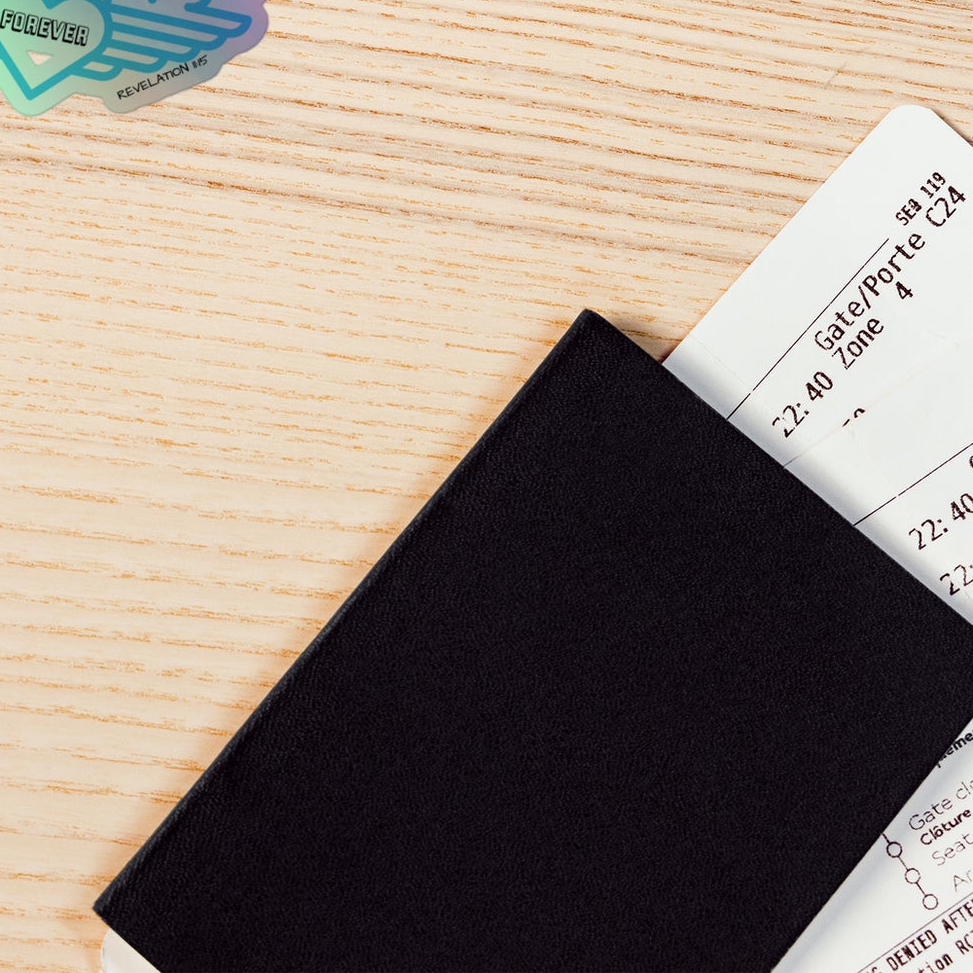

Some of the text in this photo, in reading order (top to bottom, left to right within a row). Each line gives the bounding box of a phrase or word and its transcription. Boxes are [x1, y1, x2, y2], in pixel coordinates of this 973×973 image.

[0, 9, 90, 47] FOREVER
[117, 61, 190, 101] REVELATION
[921, 172, 947, 199] 119
[815, 185, 966, 350] Gate/Porte C24
[832, 318, 885, 370] Zone
[895, 281, 914, 300] 4
[908, 798, 953, 831] Gate
[920, 809, 972, 845] Clôture
[886, 898, 973, 971] DENIED AFTE
